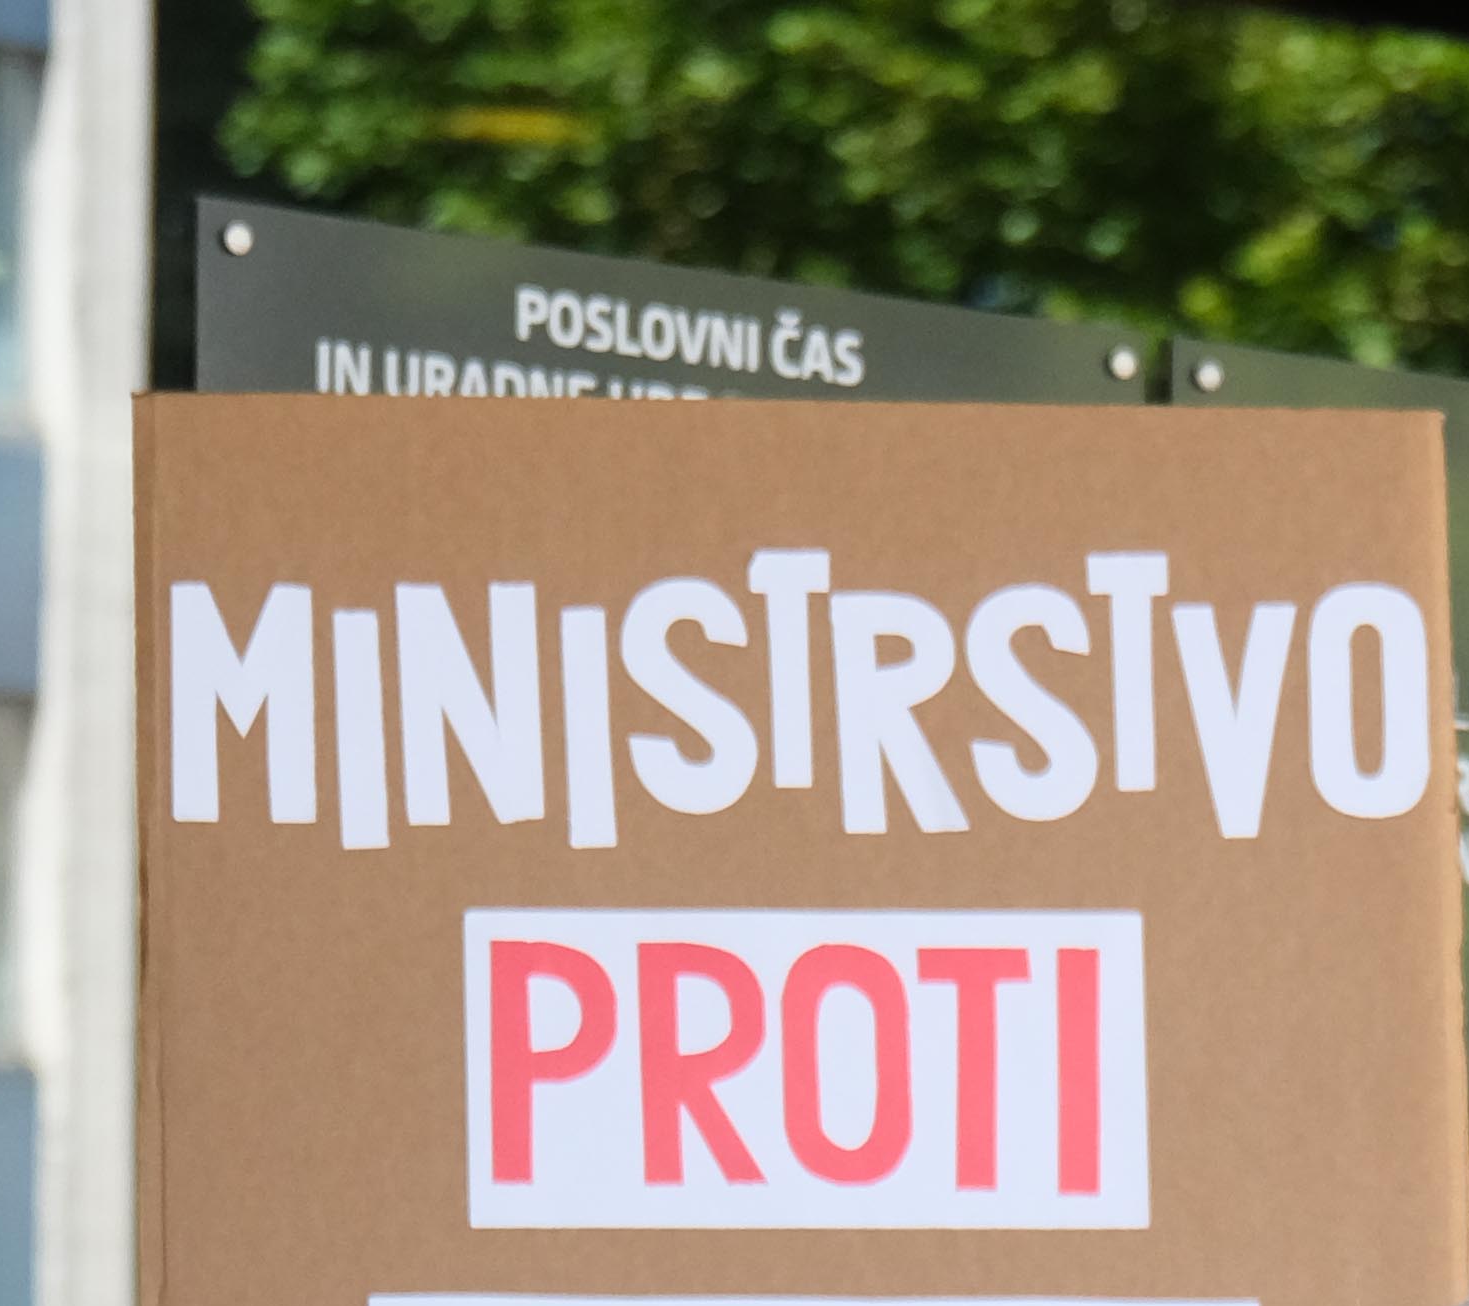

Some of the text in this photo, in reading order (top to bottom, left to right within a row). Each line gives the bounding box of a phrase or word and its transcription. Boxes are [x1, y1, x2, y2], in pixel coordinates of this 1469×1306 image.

[315, 341, 372, 396] IN
[515, 284, 866, 388] POSLOVNI ČAS
[169, 549, 1429, 849] MINISTRSTVO
[488, 941, 1101, 1196] PROTI
